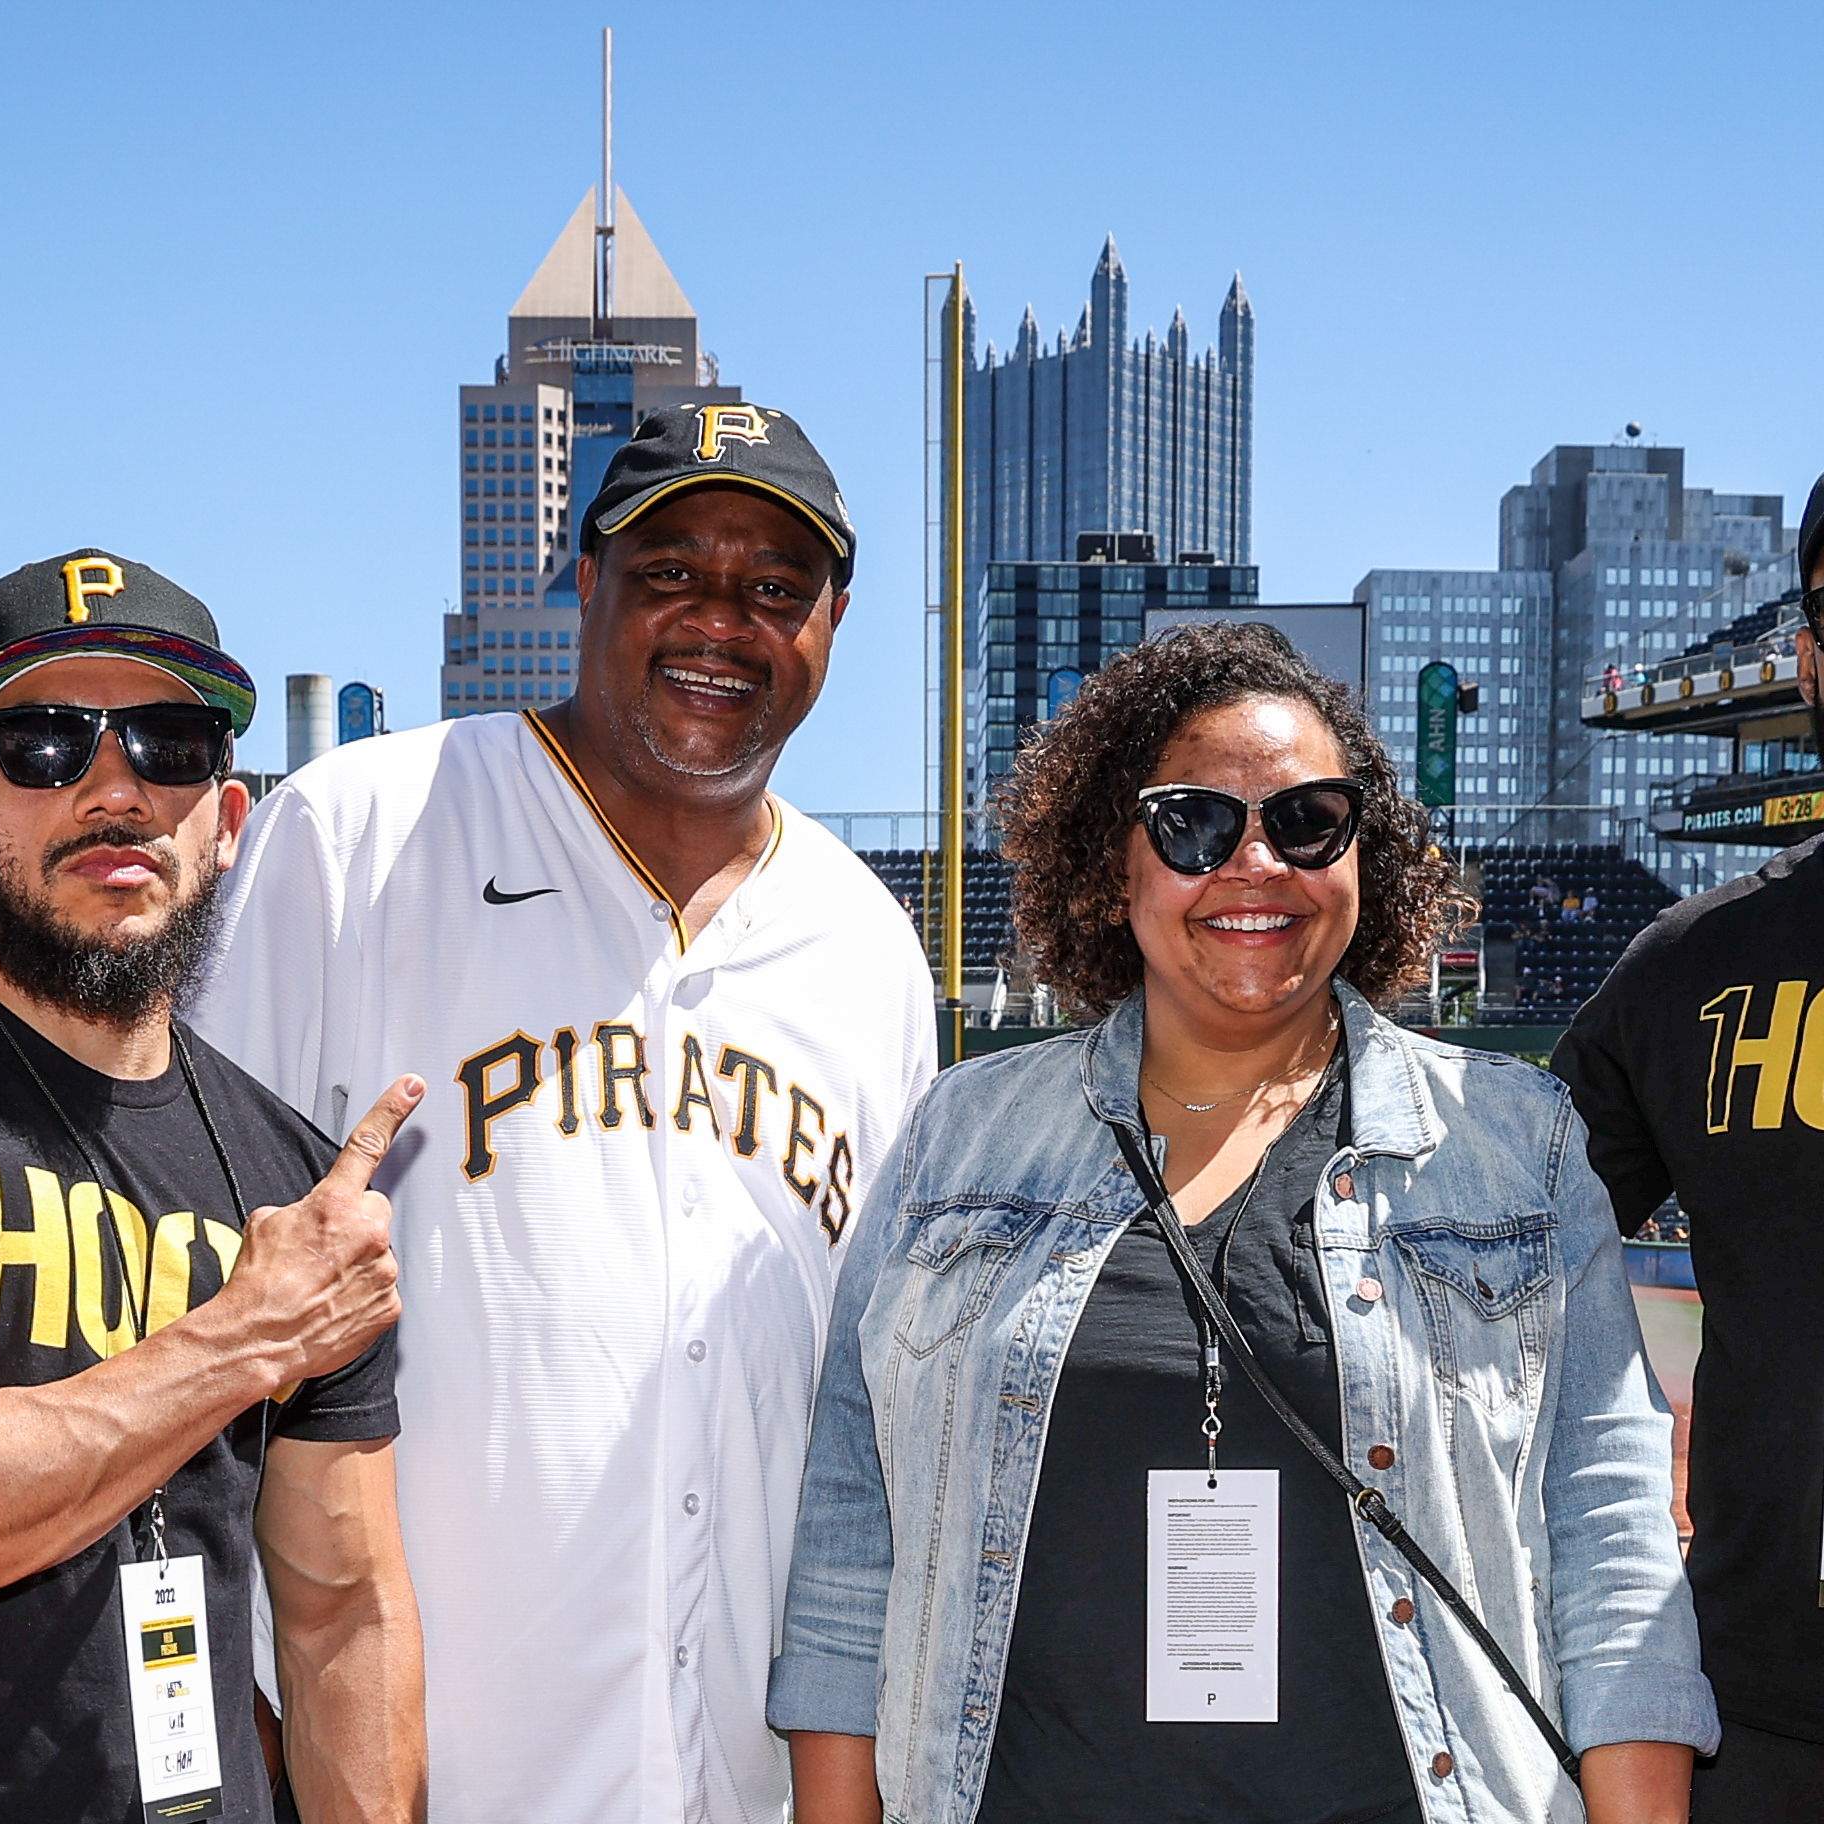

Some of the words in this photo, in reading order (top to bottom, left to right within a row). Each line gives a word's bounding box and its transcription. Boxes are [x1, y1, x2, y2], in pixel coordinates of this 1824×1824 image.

[547, 336, 674, 367] HIGHMARK
[692, 405, 771, 463] P
[62, 556, 125, 624] P
[1428, 707, 1446, 752] AHN
[1684, 805, 1762, 832] PIRATES.COM
[454, 1020, 856, 1248] PIRATES
[155, 1588, 175, 1604] 2022
[1207, 1693, 1216, 1705] P
